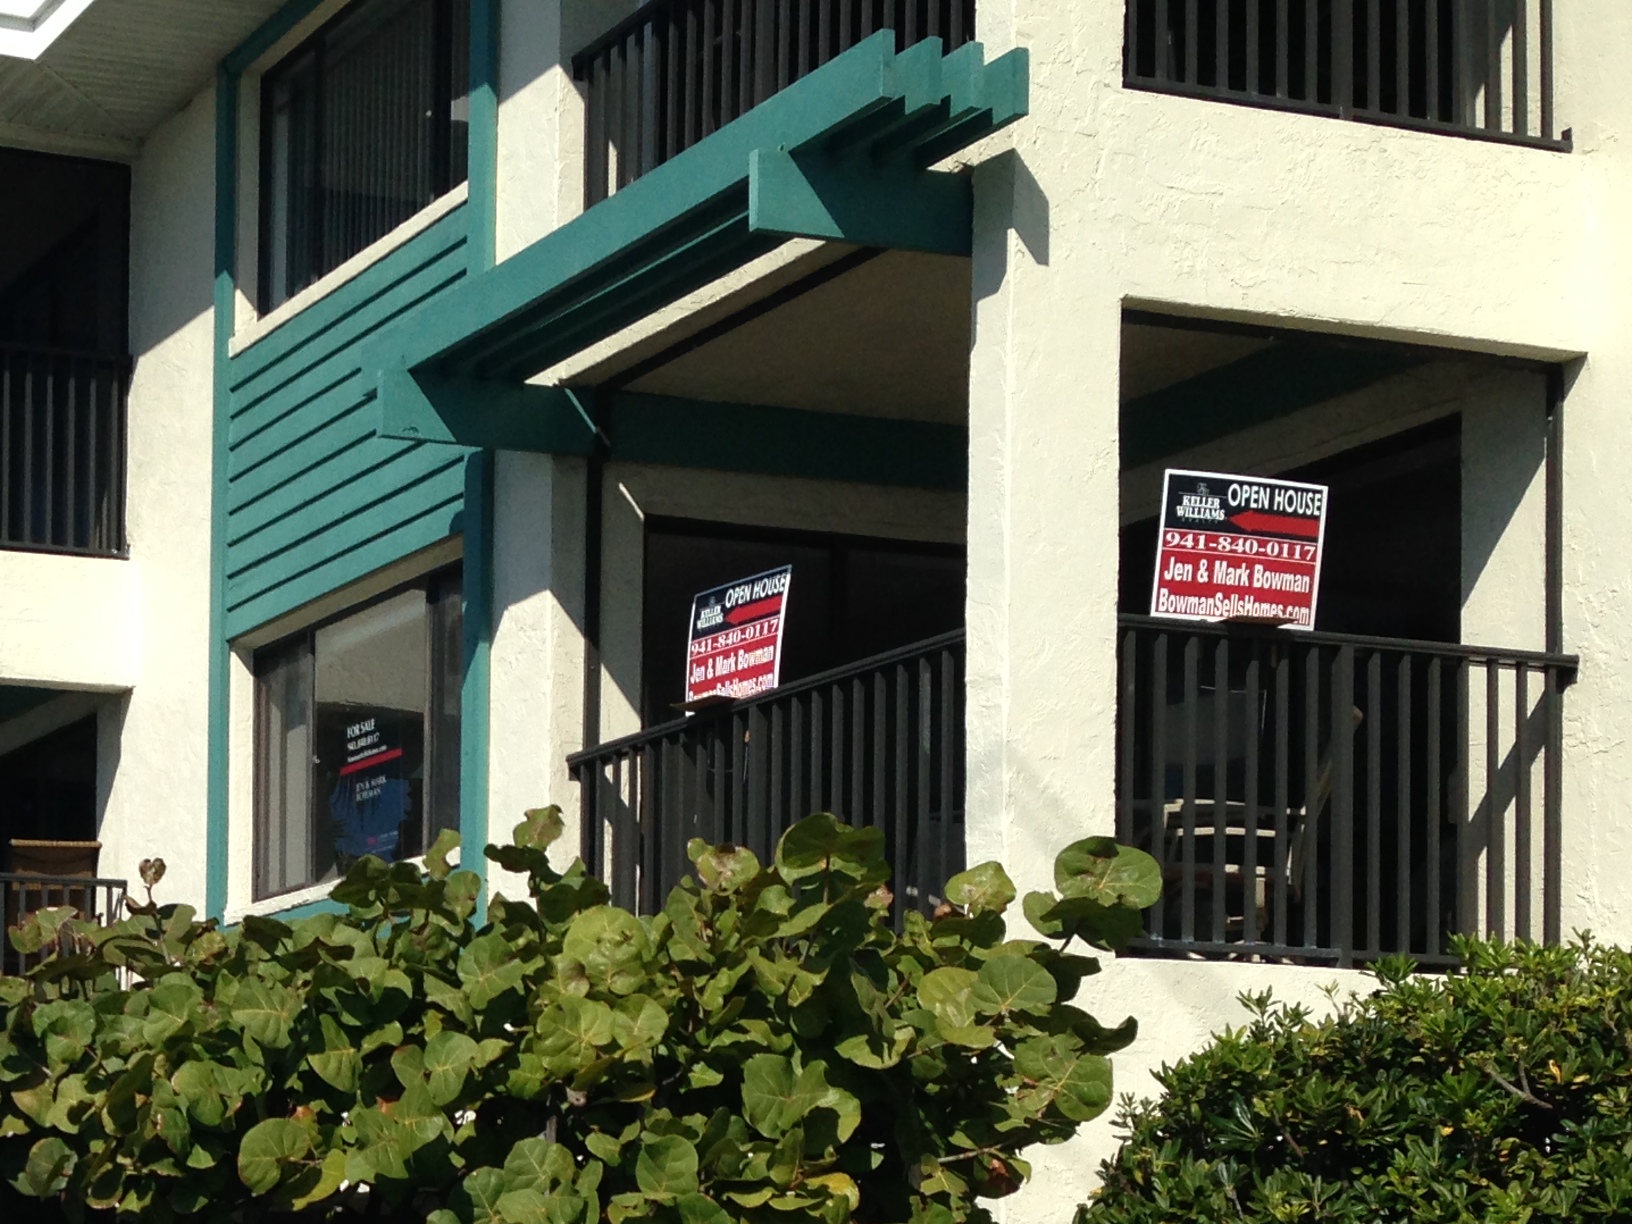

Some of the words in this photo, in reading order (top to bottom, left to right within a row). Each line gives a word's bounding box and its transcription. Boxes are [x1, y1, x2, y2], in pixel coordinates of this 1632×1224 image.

[1176, 506, 1225, 520] WILLIAMS
[1182, 495, 1220, 509] KELLER
[1228, 483, 1270, 510] OPEN
[1273, 490, 1322, 516] HOUSE
[1165, 532, 1316, 561] 941-840-0117
[1164, 557, 1193, 582] Jen
[1197, 559, 1209, 583] &
[1213, 560, 1249, 587] Mark
[1253, 564, 1310, 593] Bowman
[725, 583, 752, 609] OPEN
[753, 574, 786, 599] HOUSE
[690, 619, 779, 656] 941-840-0117
[715, 652, 736, 677] Mark
[737, 645, 774, 670] Bowman
